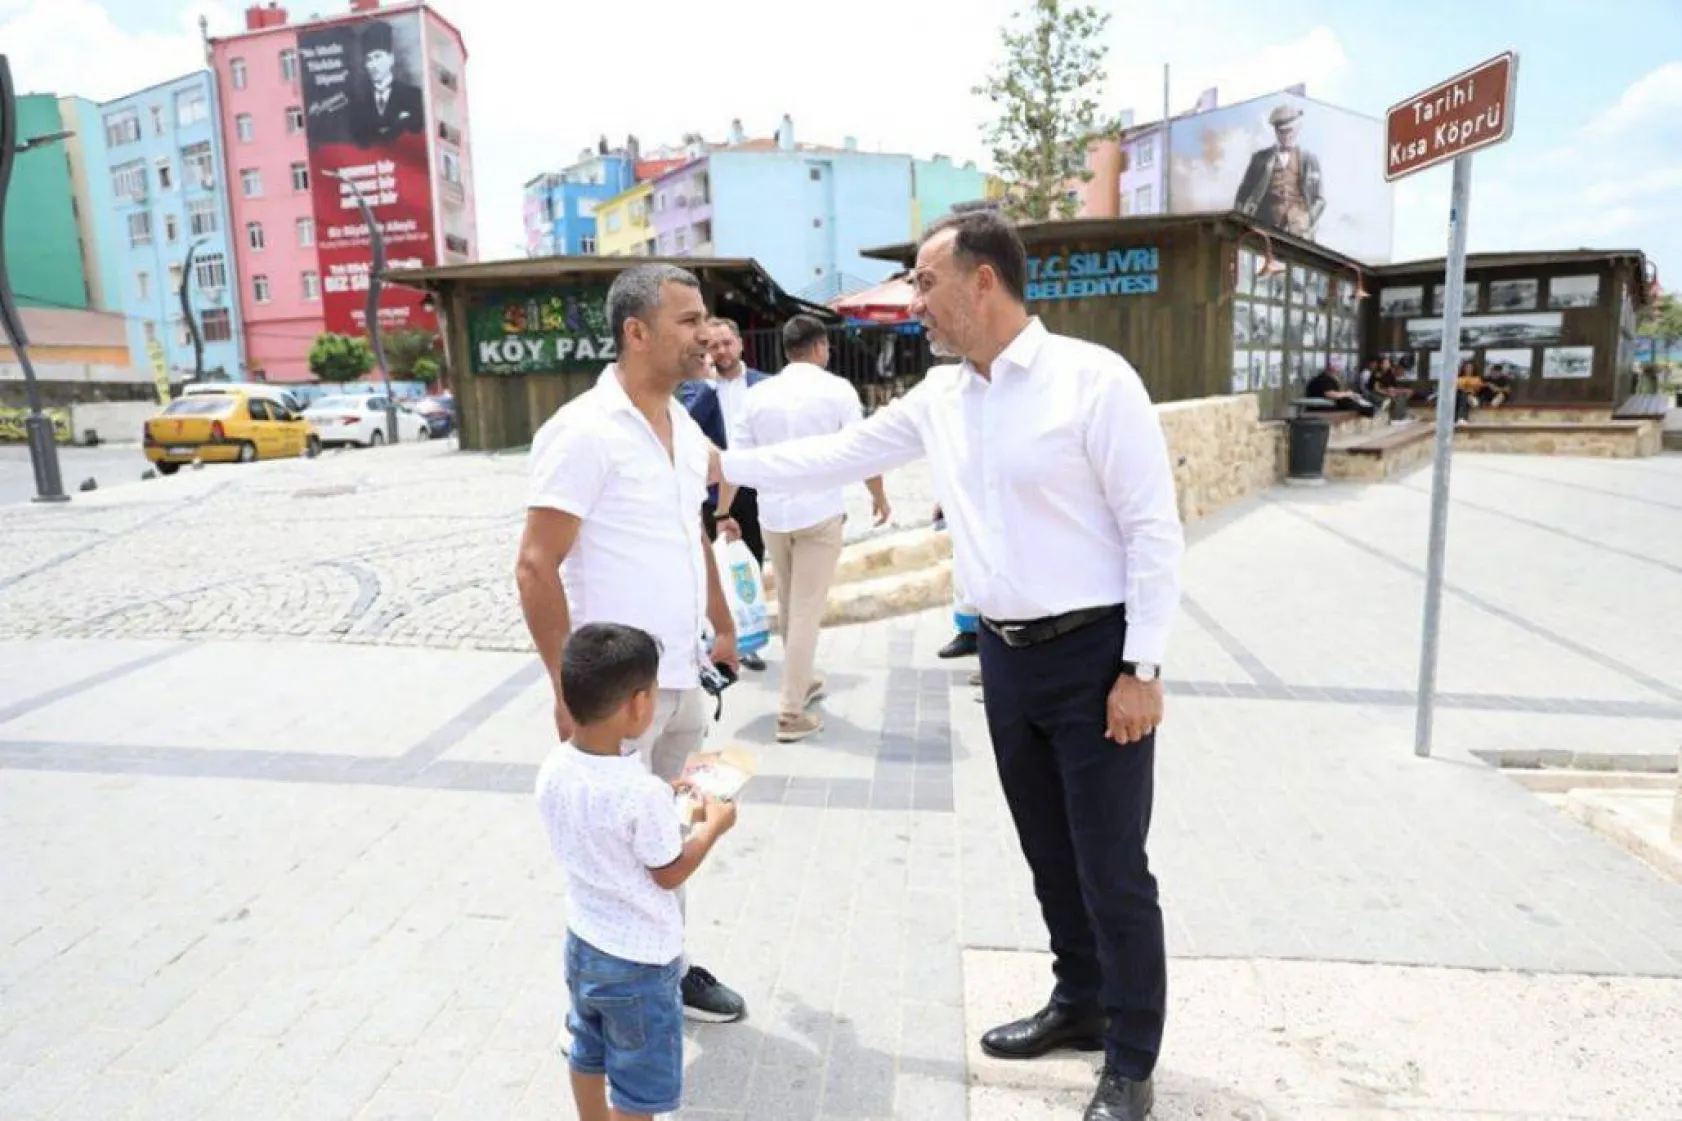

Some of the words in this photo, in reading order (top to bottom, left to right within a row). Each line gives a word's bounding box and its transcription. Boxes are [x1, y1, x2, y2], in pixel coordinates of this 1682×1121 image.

[1412, 79, 1474, 125] Tarihi
[1390, 138, 1428, 167] Kısa
[1434, 103, 1501, 148] Köprü
[479, 334, 544, 363] KÖY
